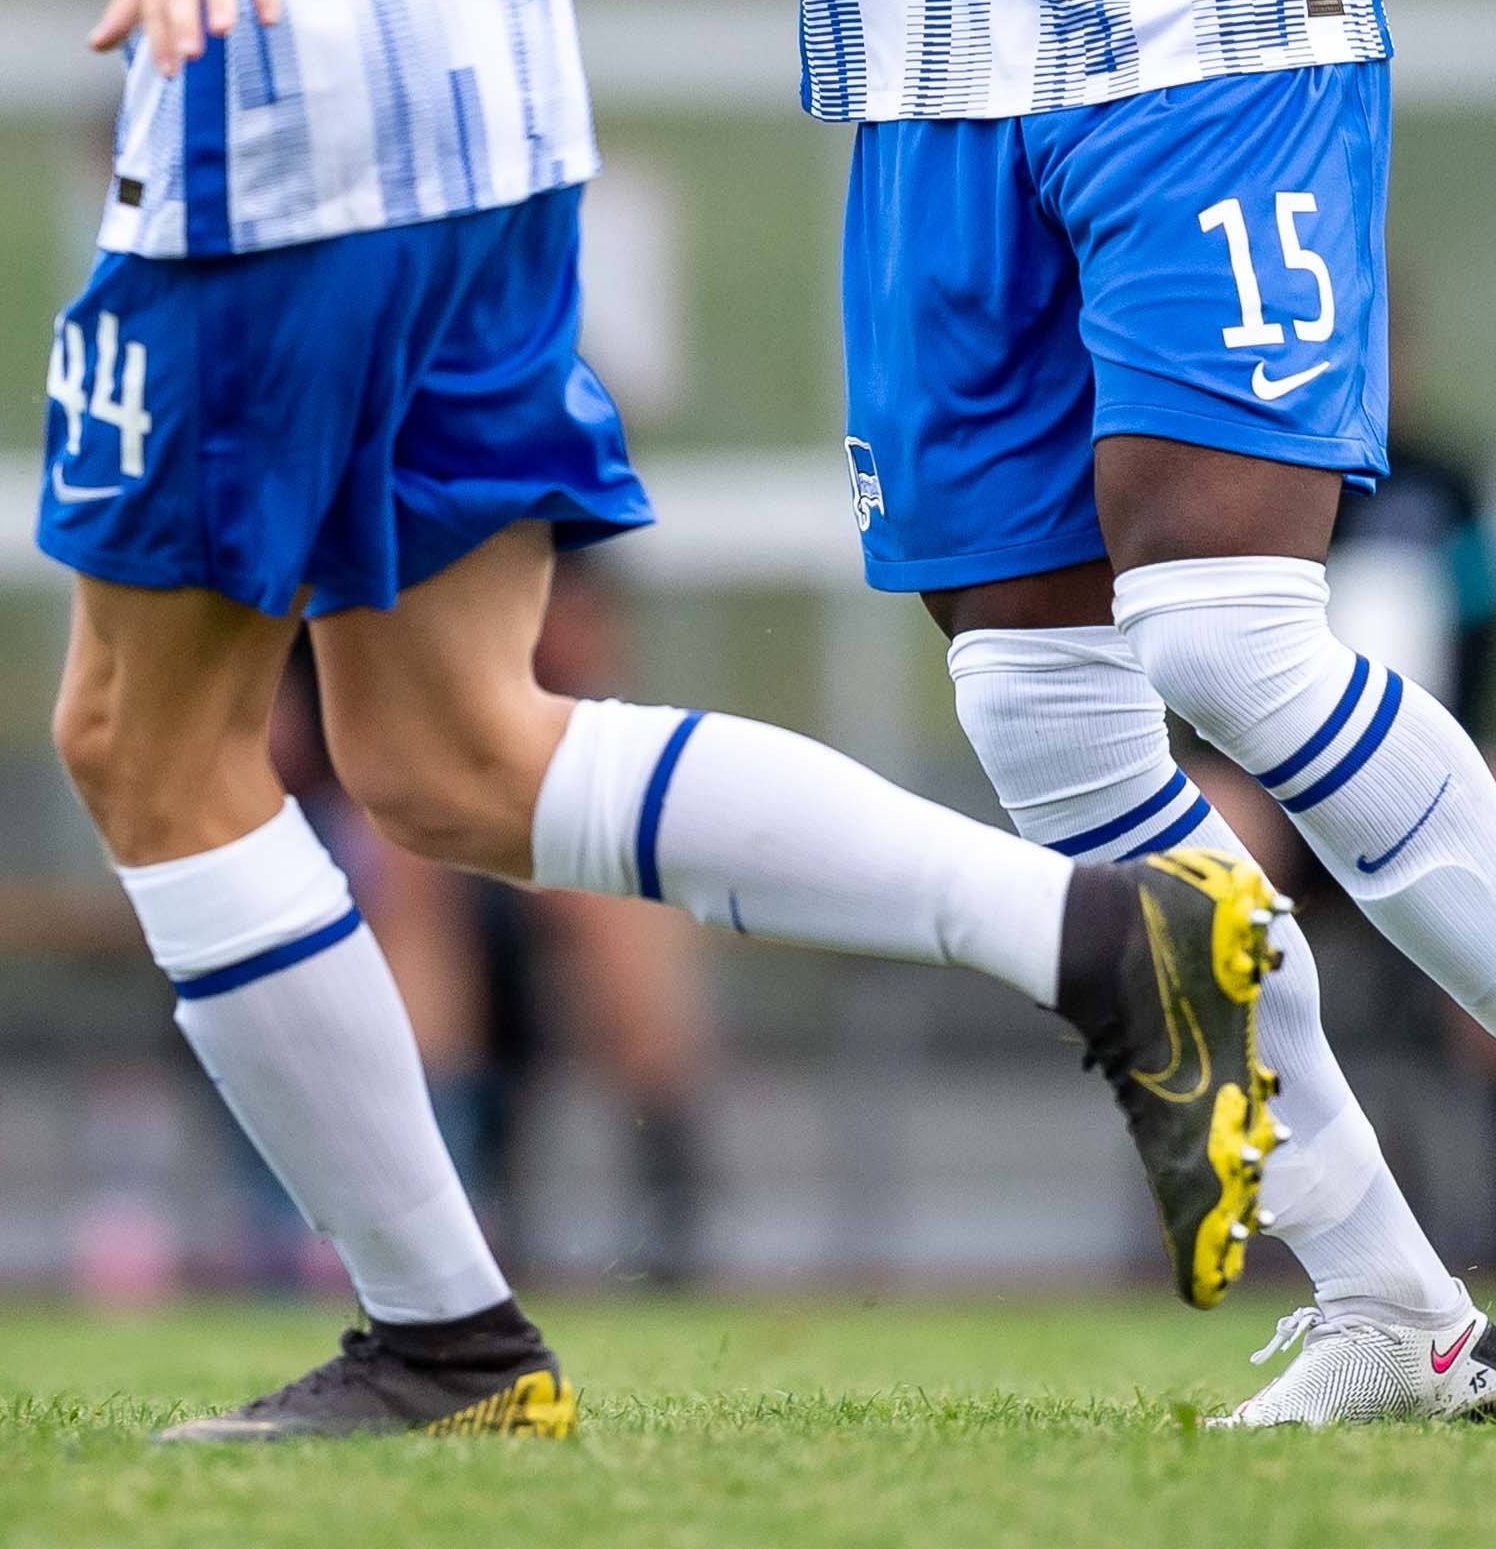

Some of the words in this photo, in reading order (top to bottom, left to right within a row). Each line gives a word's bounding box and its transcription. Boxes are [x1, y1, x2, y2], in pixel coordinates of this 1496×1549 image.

[1198, 191, 1336, 349] 15
[46, 309, 152, 480] 44
[1469, 1368, 1489, 1394] 15
